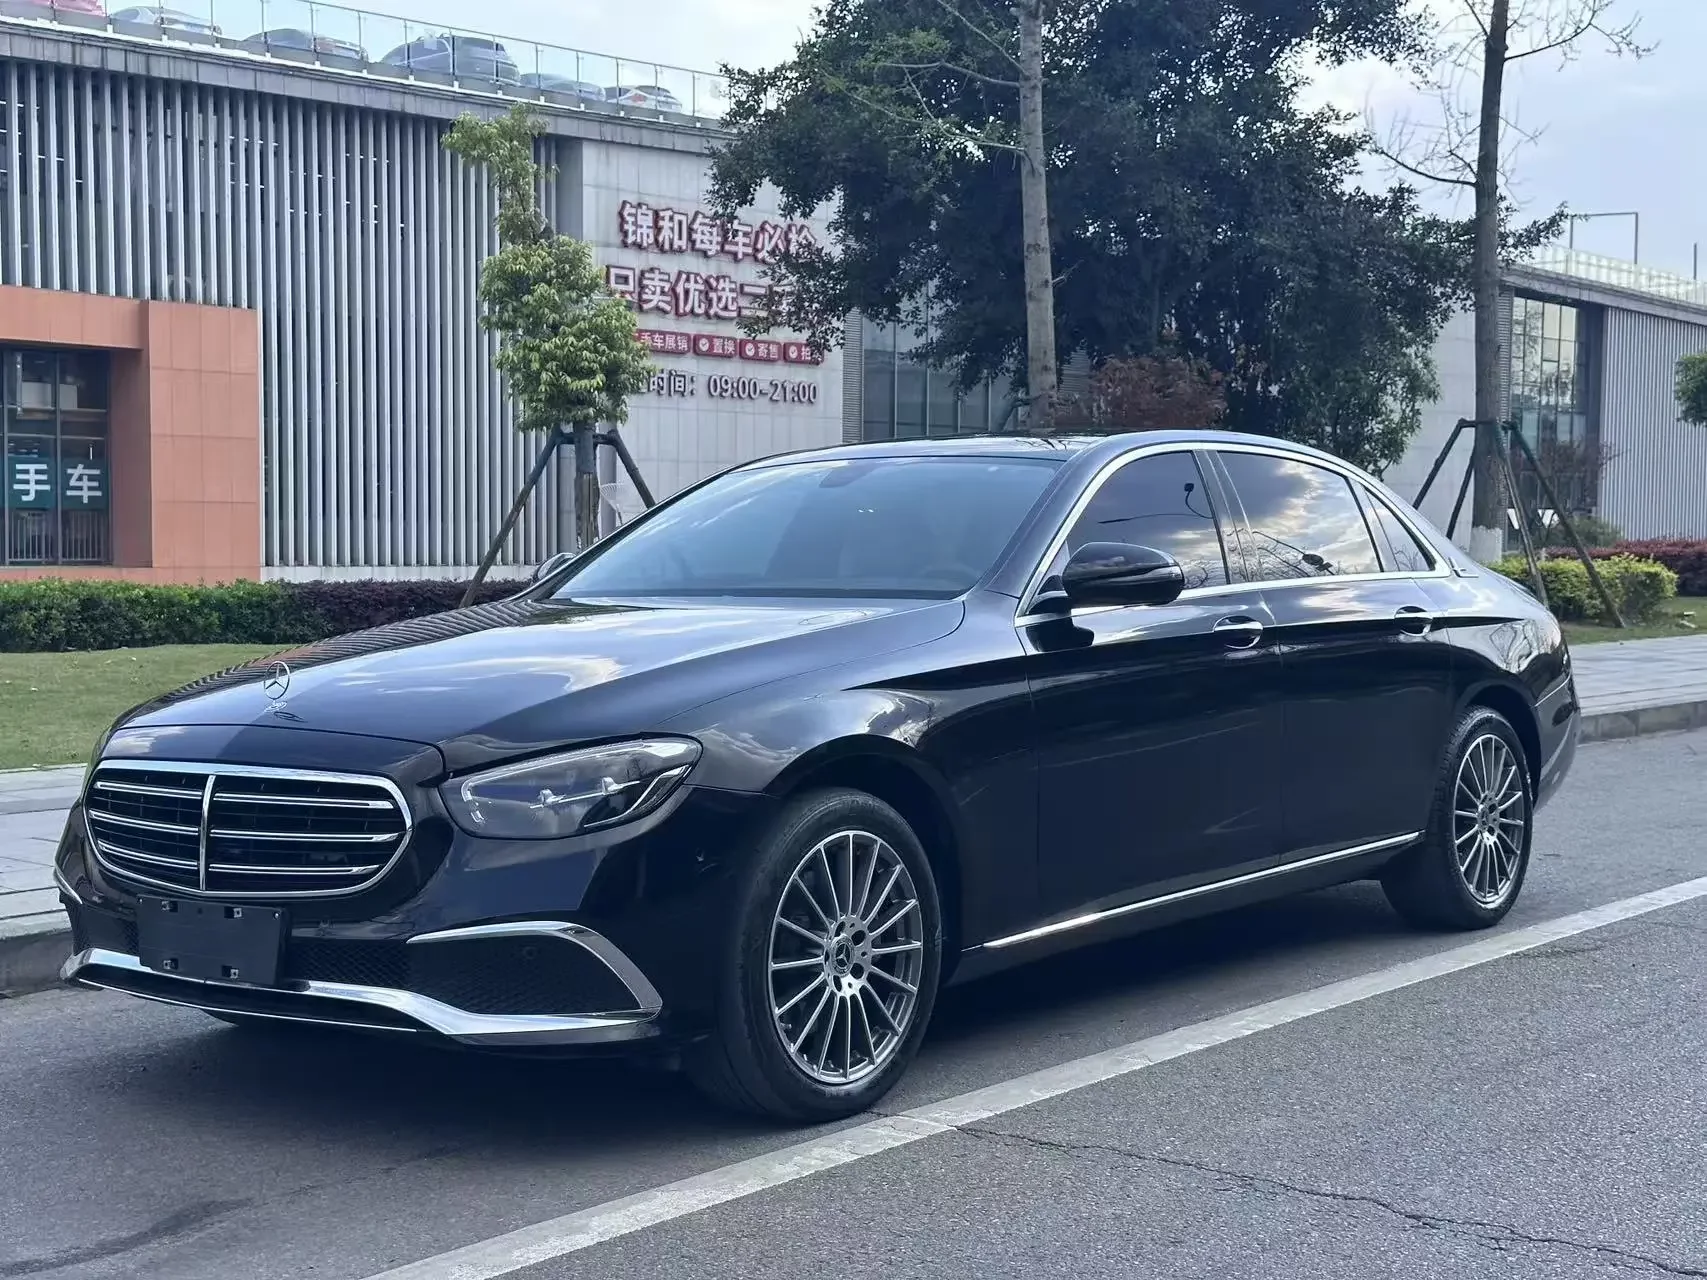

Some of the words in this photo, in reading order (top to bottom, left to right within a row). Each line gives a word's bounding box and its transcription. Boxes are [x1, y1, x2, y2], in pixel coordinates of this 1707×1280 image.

[633, 332, 689, 351] 手车展销
[713, 338, 736, 354] 置换
[757, 343, 779, 359] 寄售
[801, 345, 822, 361] 拍
[708, 375, 818, 403] 09:00-21:00
